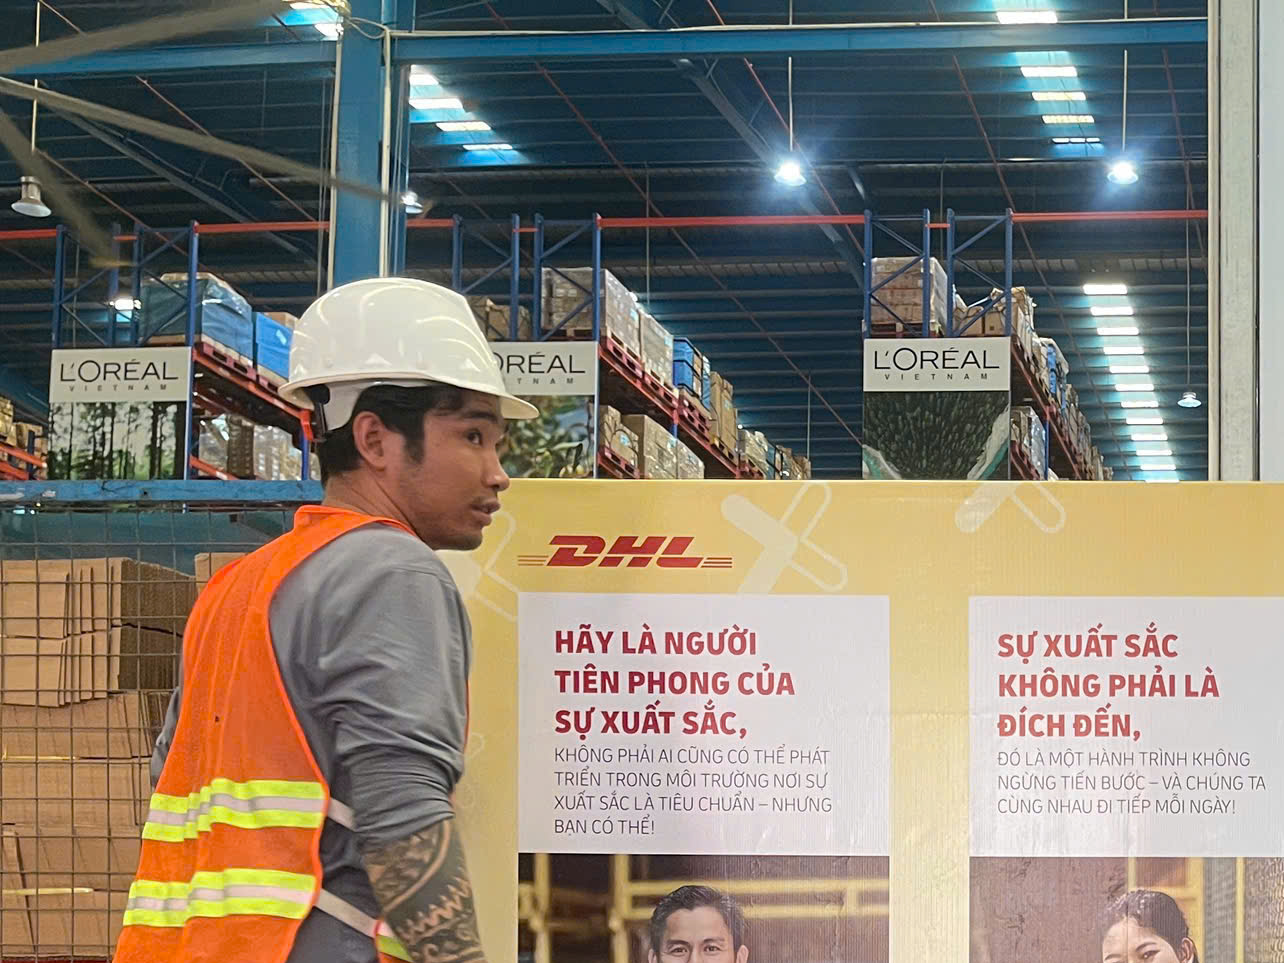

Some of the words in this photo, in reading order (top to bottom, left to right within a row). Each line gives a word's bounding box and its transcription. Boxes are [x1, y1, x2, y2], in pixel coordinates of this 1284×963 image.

[61, 359, 178, 382] L'ORÉAL
[875, 347, 999, 371] L'ORÉAL
[70, 384, 166, 392] VIETNAM
[546, 535, 704, 569] DHL
[556, 624, 613, 653] HÃY
[622, 623, 656, 654] LÀ
[665, 624, 755, 655] NGƯỜI
[998, 631, 1038, 664] SỰ
[1044, 623, 1117, 657] XUẤT
[1125, 622, 1178, 657] SẮC
[554, 663, 619, 693] TIÊN
[629, 671, 729, 695] PHONG
[738, 663, 795, 695] CỦA
[999, 667, 1100, 697] KHÔNG
[1109, 665, 1175, 697] PHẢI
[1185, 666, 1219, 697] LÀ
[555, 707, 595, 740] SỰ
[601, 700, 675, 734] XUẤT
[682, 699, 746, 739] SẮC,
[997, 706, 1065, 737] ĐÍCH
[1073, 703, 1140, 741] ĐẾN,
[555, 744, 613, 763] KHÔNG
[618, 744, 653, 763] PHẢI
[658, 749, 672, 763] AI
[678, 746, 723, 764] CŨNG
[728, 746, 749, 764] CÓ
[753, 744, 785, 764] THỂ
[790, 746, 830, 764] PHÁT
[997, 748, 1020, 766] ĐÓ
[1026, 748, 1045, 766] LÀ
[1050, 748, 1083, 768] MỘT
[1089, 748, 1134, 766] HÀNH
[1139, 748, 1187, 766] TRÌNH
[1193, 748, 1250, 766] KHÔNG
[554, 766, 600, 786] TRIỂN
[606, 772, 661, 787] TRONG
[667, 769, 695, 787] MÔI
[700, 770, 768, 788] TRƯỜNG
[774, 772, 800, 788] NƠI
[806, 772, 828, 790] SỰ
[998, 772, 1056, 790] NGỪNG
[1061, 770, 1095, 790] TIẾN
[1102, 770, 1145, 790] BƯỚC
[1162, 772, 1182, 790] VÀ
[1186, 772, 1243, 790] CHÚNG
[1248, 776, 1265, 790] TA
[554, 790, 595, 810] XUẤT
[600, 790, 629, 810] SẮC
[635, 793, 654, 810] LÀ
[658, 793, 693, 811] TIÊU
[699, 791, 754, 811] CHUẨN
[773, 796, 832, 812] NHƯNG
[998, 795, 1042, 813] CÙNG
[1048, 799, 1092, 814] NHAU
[1097, 800, 1112, 813] ĐI
[1117, 793, 1151, 814] TIẾP
[1156, 793, 1184, 814] MỖI
[1190, 796, 1235, 814] NGÀY!
[555, 819, 586, 836] BẠN
[592, 816, 613, 834] CÓ
[618, 814, 654, 834] THỂ!
